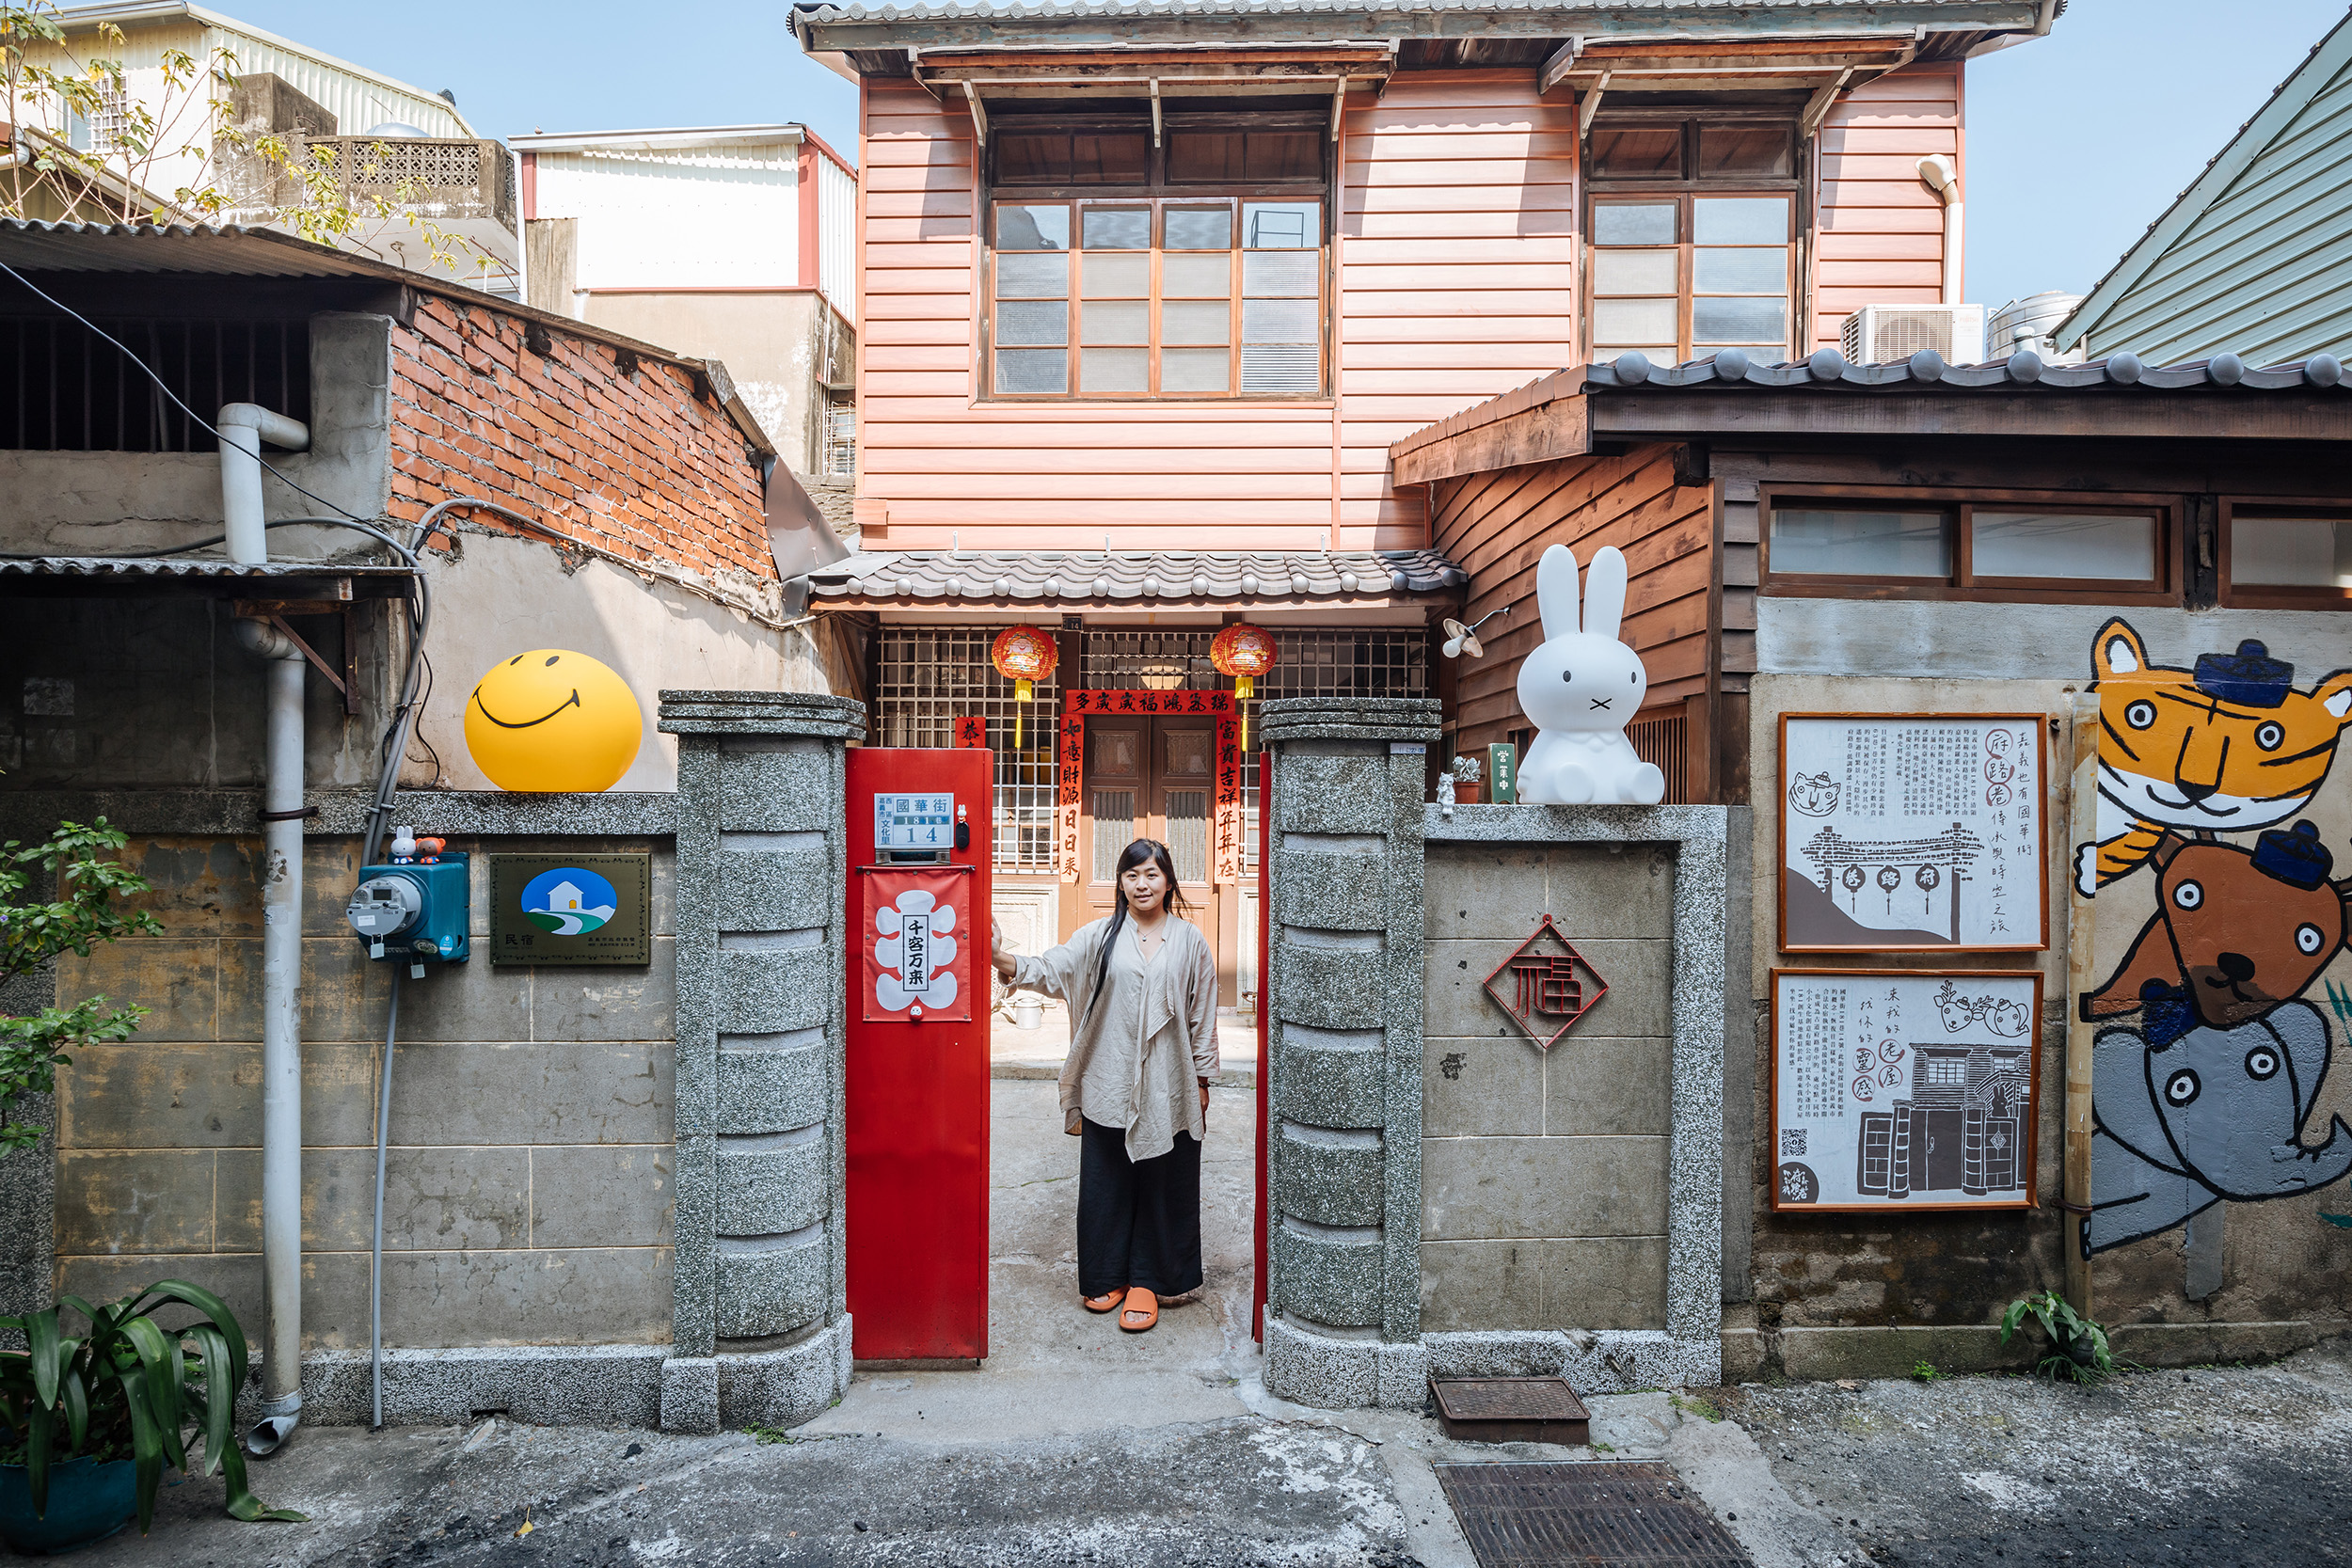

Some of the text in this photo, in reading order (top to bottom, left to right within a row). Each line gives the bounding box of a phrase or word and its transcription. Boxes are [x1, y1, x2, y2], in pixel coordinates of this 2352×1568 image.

[1216, 720, 1238, 879] 富貴吉祥年年在
[2017, 732, 2032, 856] 嘉義也有國華街
[885, 798, 893, 817] 西區
[896, 799, 947, 813] 國華街
[904, 816, 943, 825] 181巷
[881, 819, 891, 845] 文化里
[907, 827, 938, 843] 14
[505, 934, 534, 945] 民宿
[1511, 955, 1582, 1019] 福
